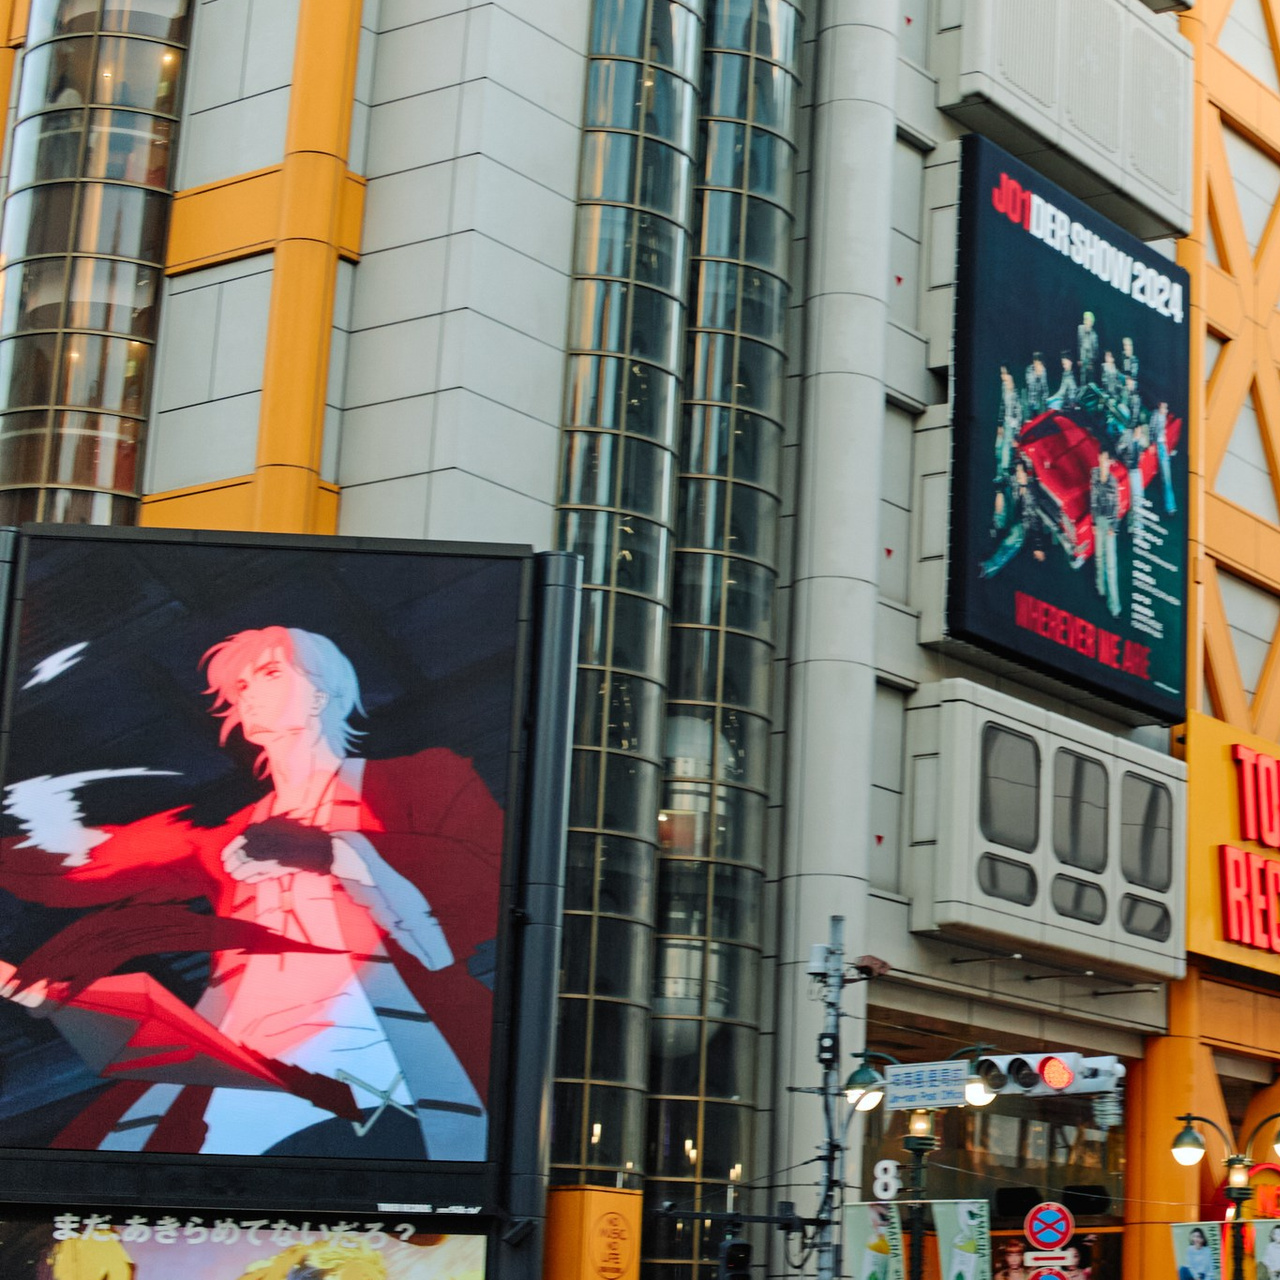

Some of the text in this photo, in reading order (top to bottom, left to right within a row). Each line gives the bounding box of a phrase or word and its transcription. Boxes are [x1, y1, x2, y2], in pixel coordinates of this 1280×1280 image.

[1070, 221, 1134, 295] SHOW
[1132, 260, 1185, 324] 2024
[872, 1159, 902, 1200] 8
[52, 1212, 416, 1250] まだ、あきらめてないだろ？
